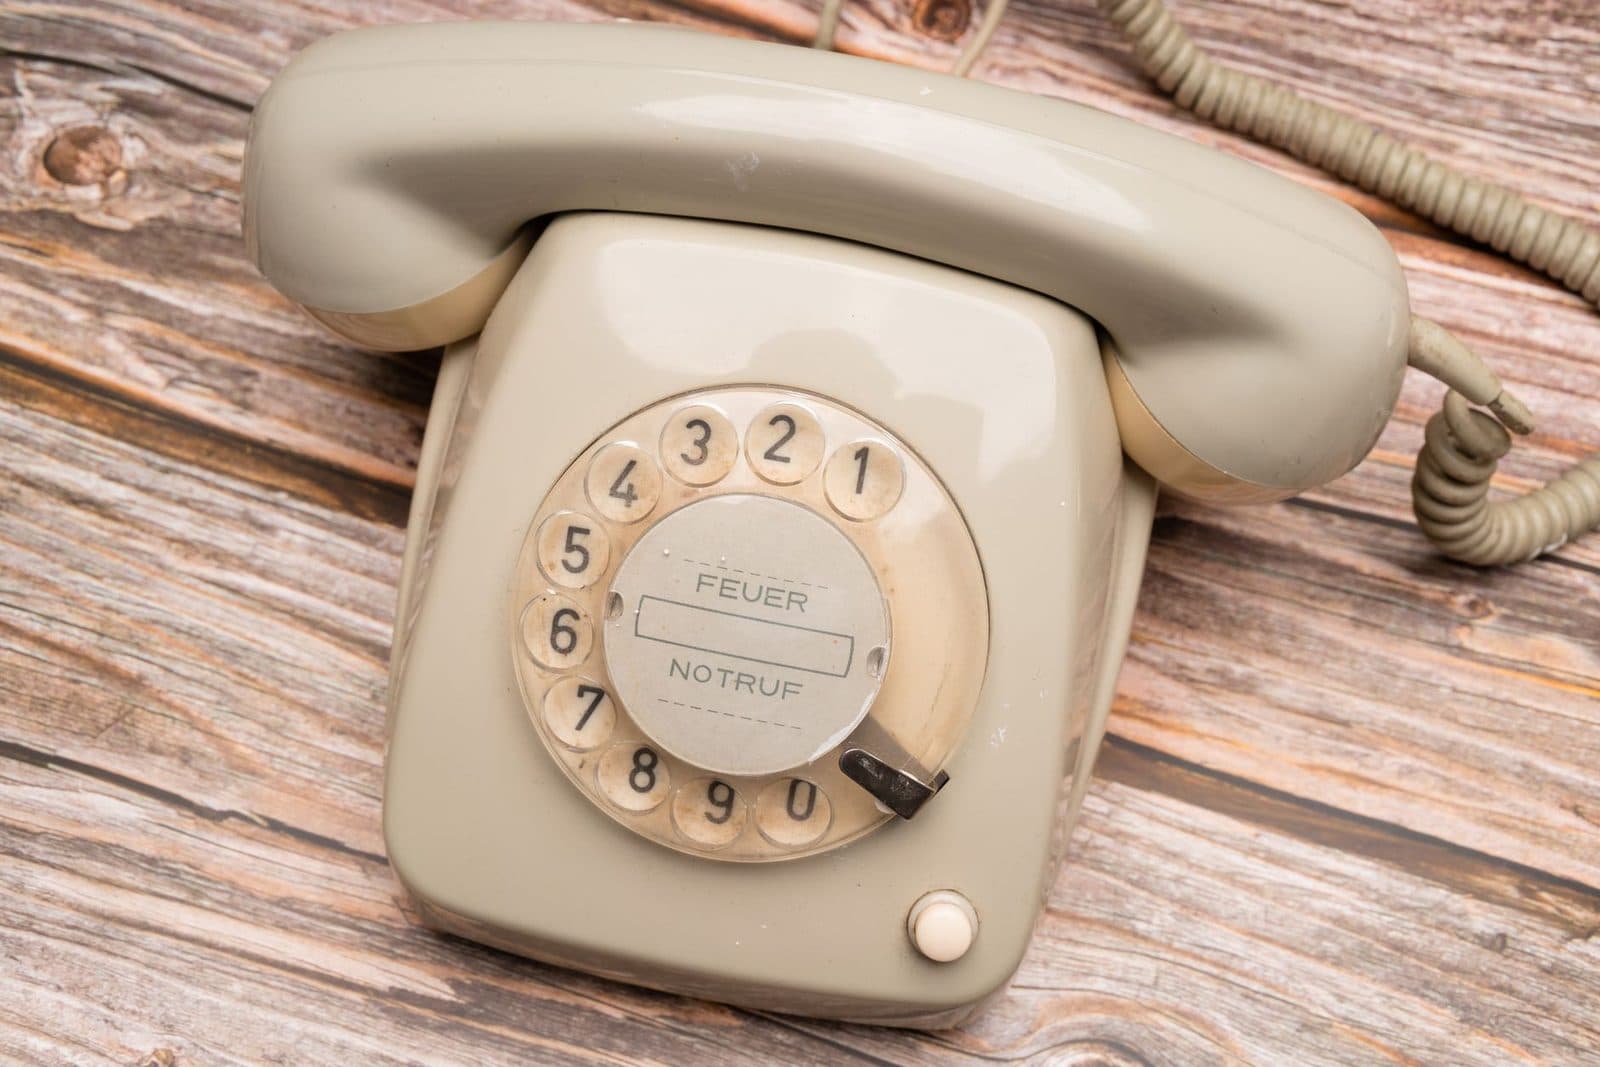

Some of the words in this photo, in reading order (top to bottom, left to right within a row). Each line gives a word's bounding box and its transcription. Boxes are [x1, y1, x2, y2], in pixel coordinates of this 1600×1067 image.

[680, 418, 712, 466] 3
[763, 414, 797, 464] 2
[609, 460, 639, 508] 4
[853, 447, 869, 495] 1
[561, 525, 592, 574] 5
[695, 572, 809, 613] FEUER
[549, 608, 578, 655] 6
[669, 658, 804, 701] NOTRUF
[574, 684, 606, 731] 7
[628, 747, 658, 794] 8
[704, 780, 735, 825] 9
[786, 779, 817, 822] 0
